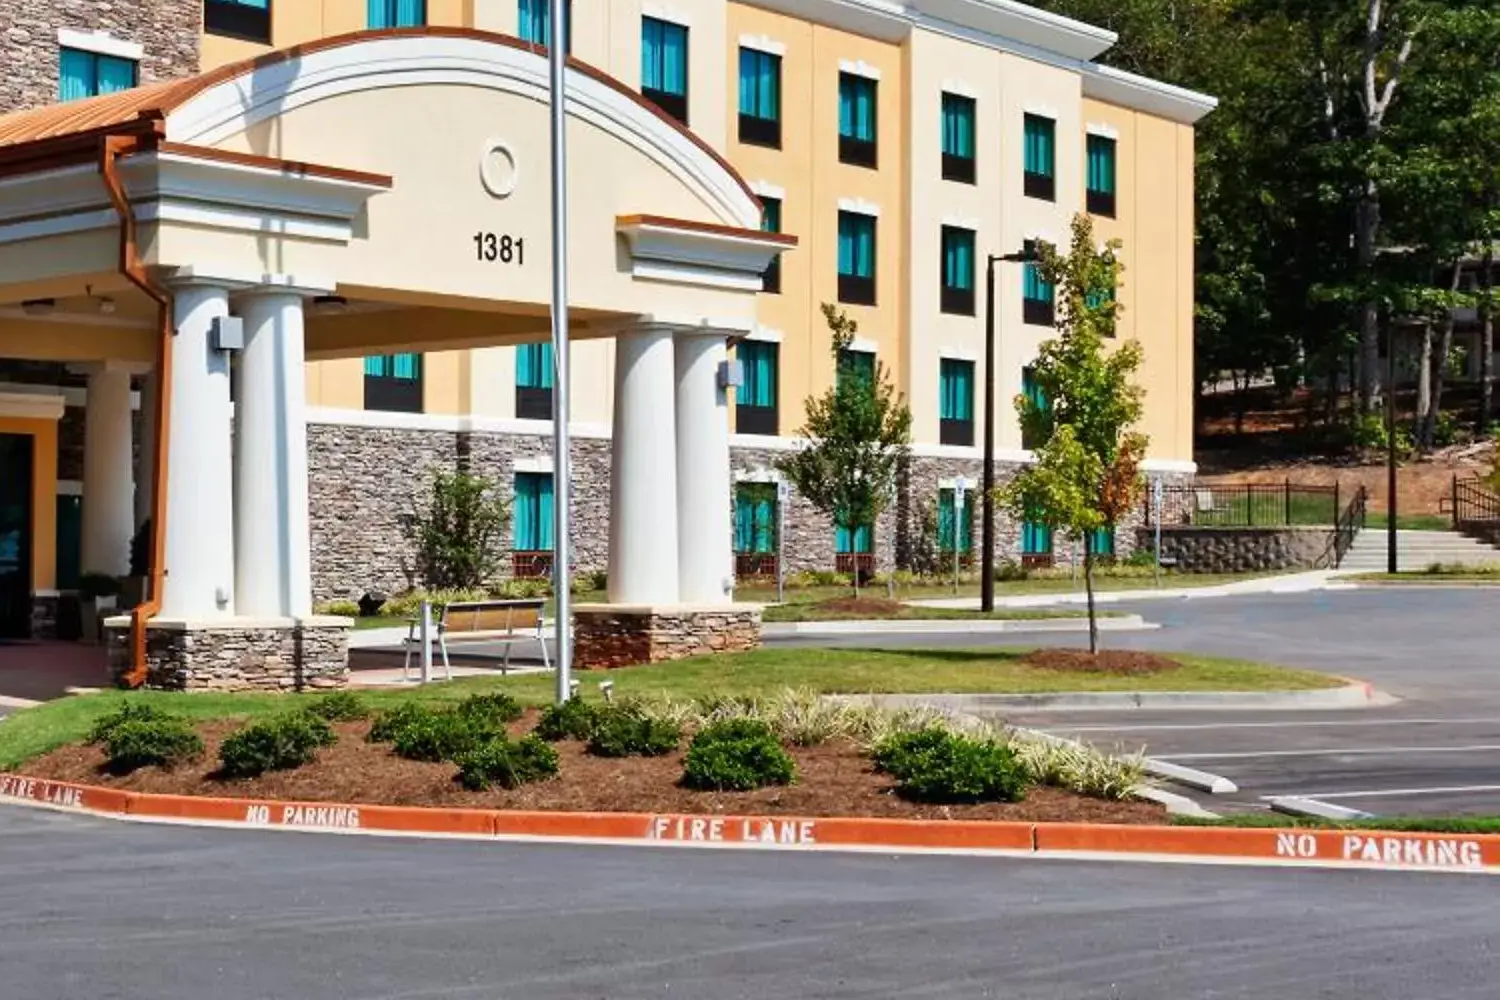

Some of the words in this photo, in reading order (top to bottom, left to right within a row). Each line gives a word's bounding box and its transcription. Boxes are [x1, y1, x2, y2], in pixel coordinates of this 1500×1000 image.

[473, 231, 523, 265] 1381
[2, 778, 37, 797] FIRE
[43, 781, 84, 806] LANE
[246, 804, 269, 824] NO
[283, 806, 359, 828] PARKING
[655, 818, 725, 841] FIRE
[743, 819, 816, 844] LANE
[1276, 833, 1317, 857] NO
[1343, 836, 1484, 869] PARKING
